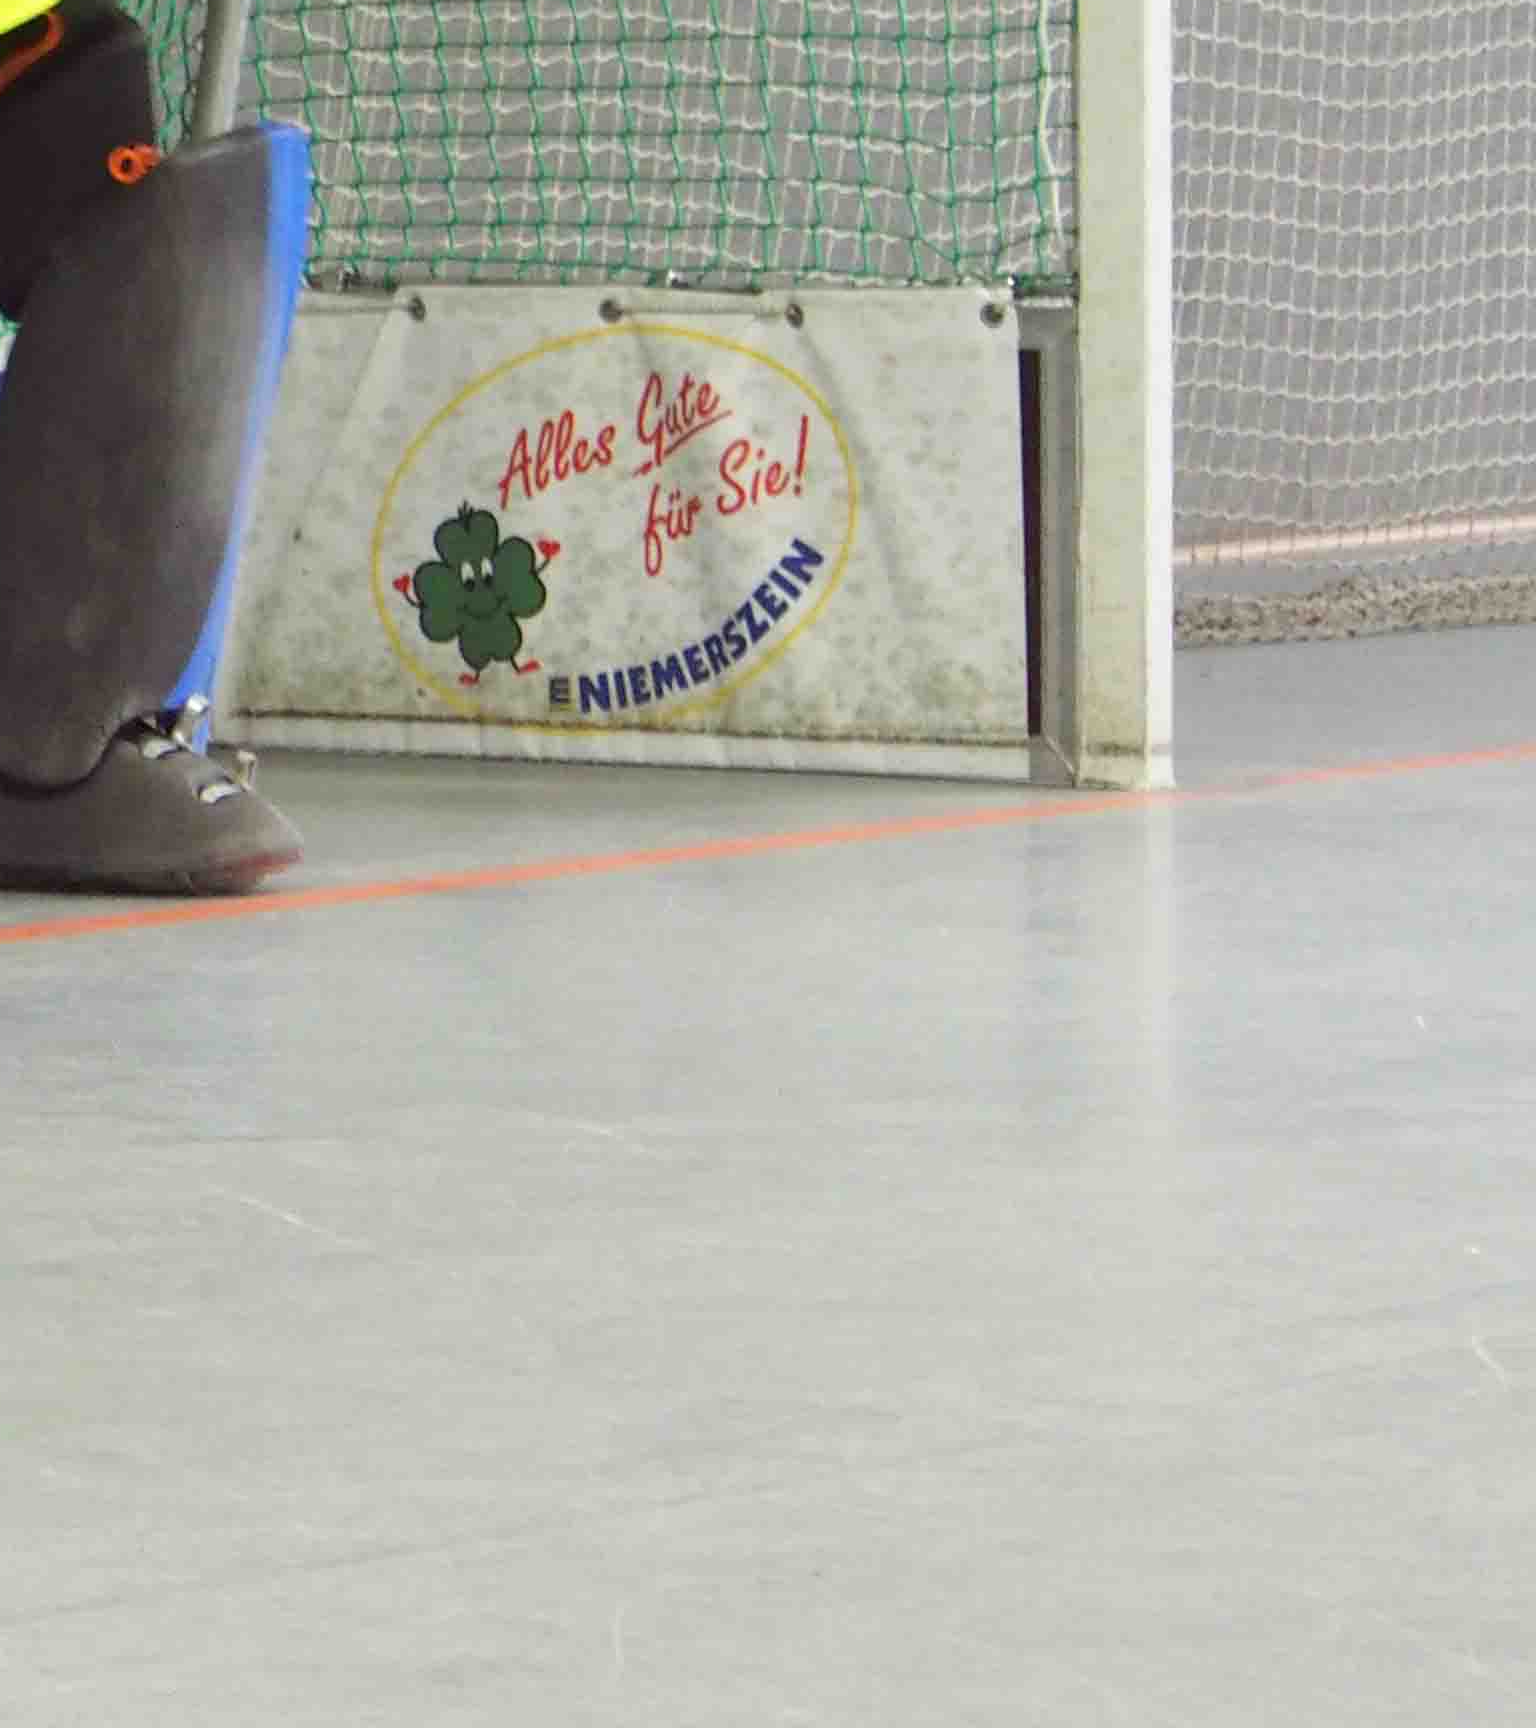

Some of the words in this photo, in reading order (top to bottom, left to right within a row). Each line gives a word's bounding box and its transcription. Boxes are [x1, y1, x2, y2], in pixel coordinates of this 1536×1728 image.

[498, 409, 617, 511] Alles
[634, 370, 726, 470] Gute
[644, 482, 703, 576] für
[716, 414, 810, 515] Sie!
[578, 537, 825, 714] NIEMERSZEIN
